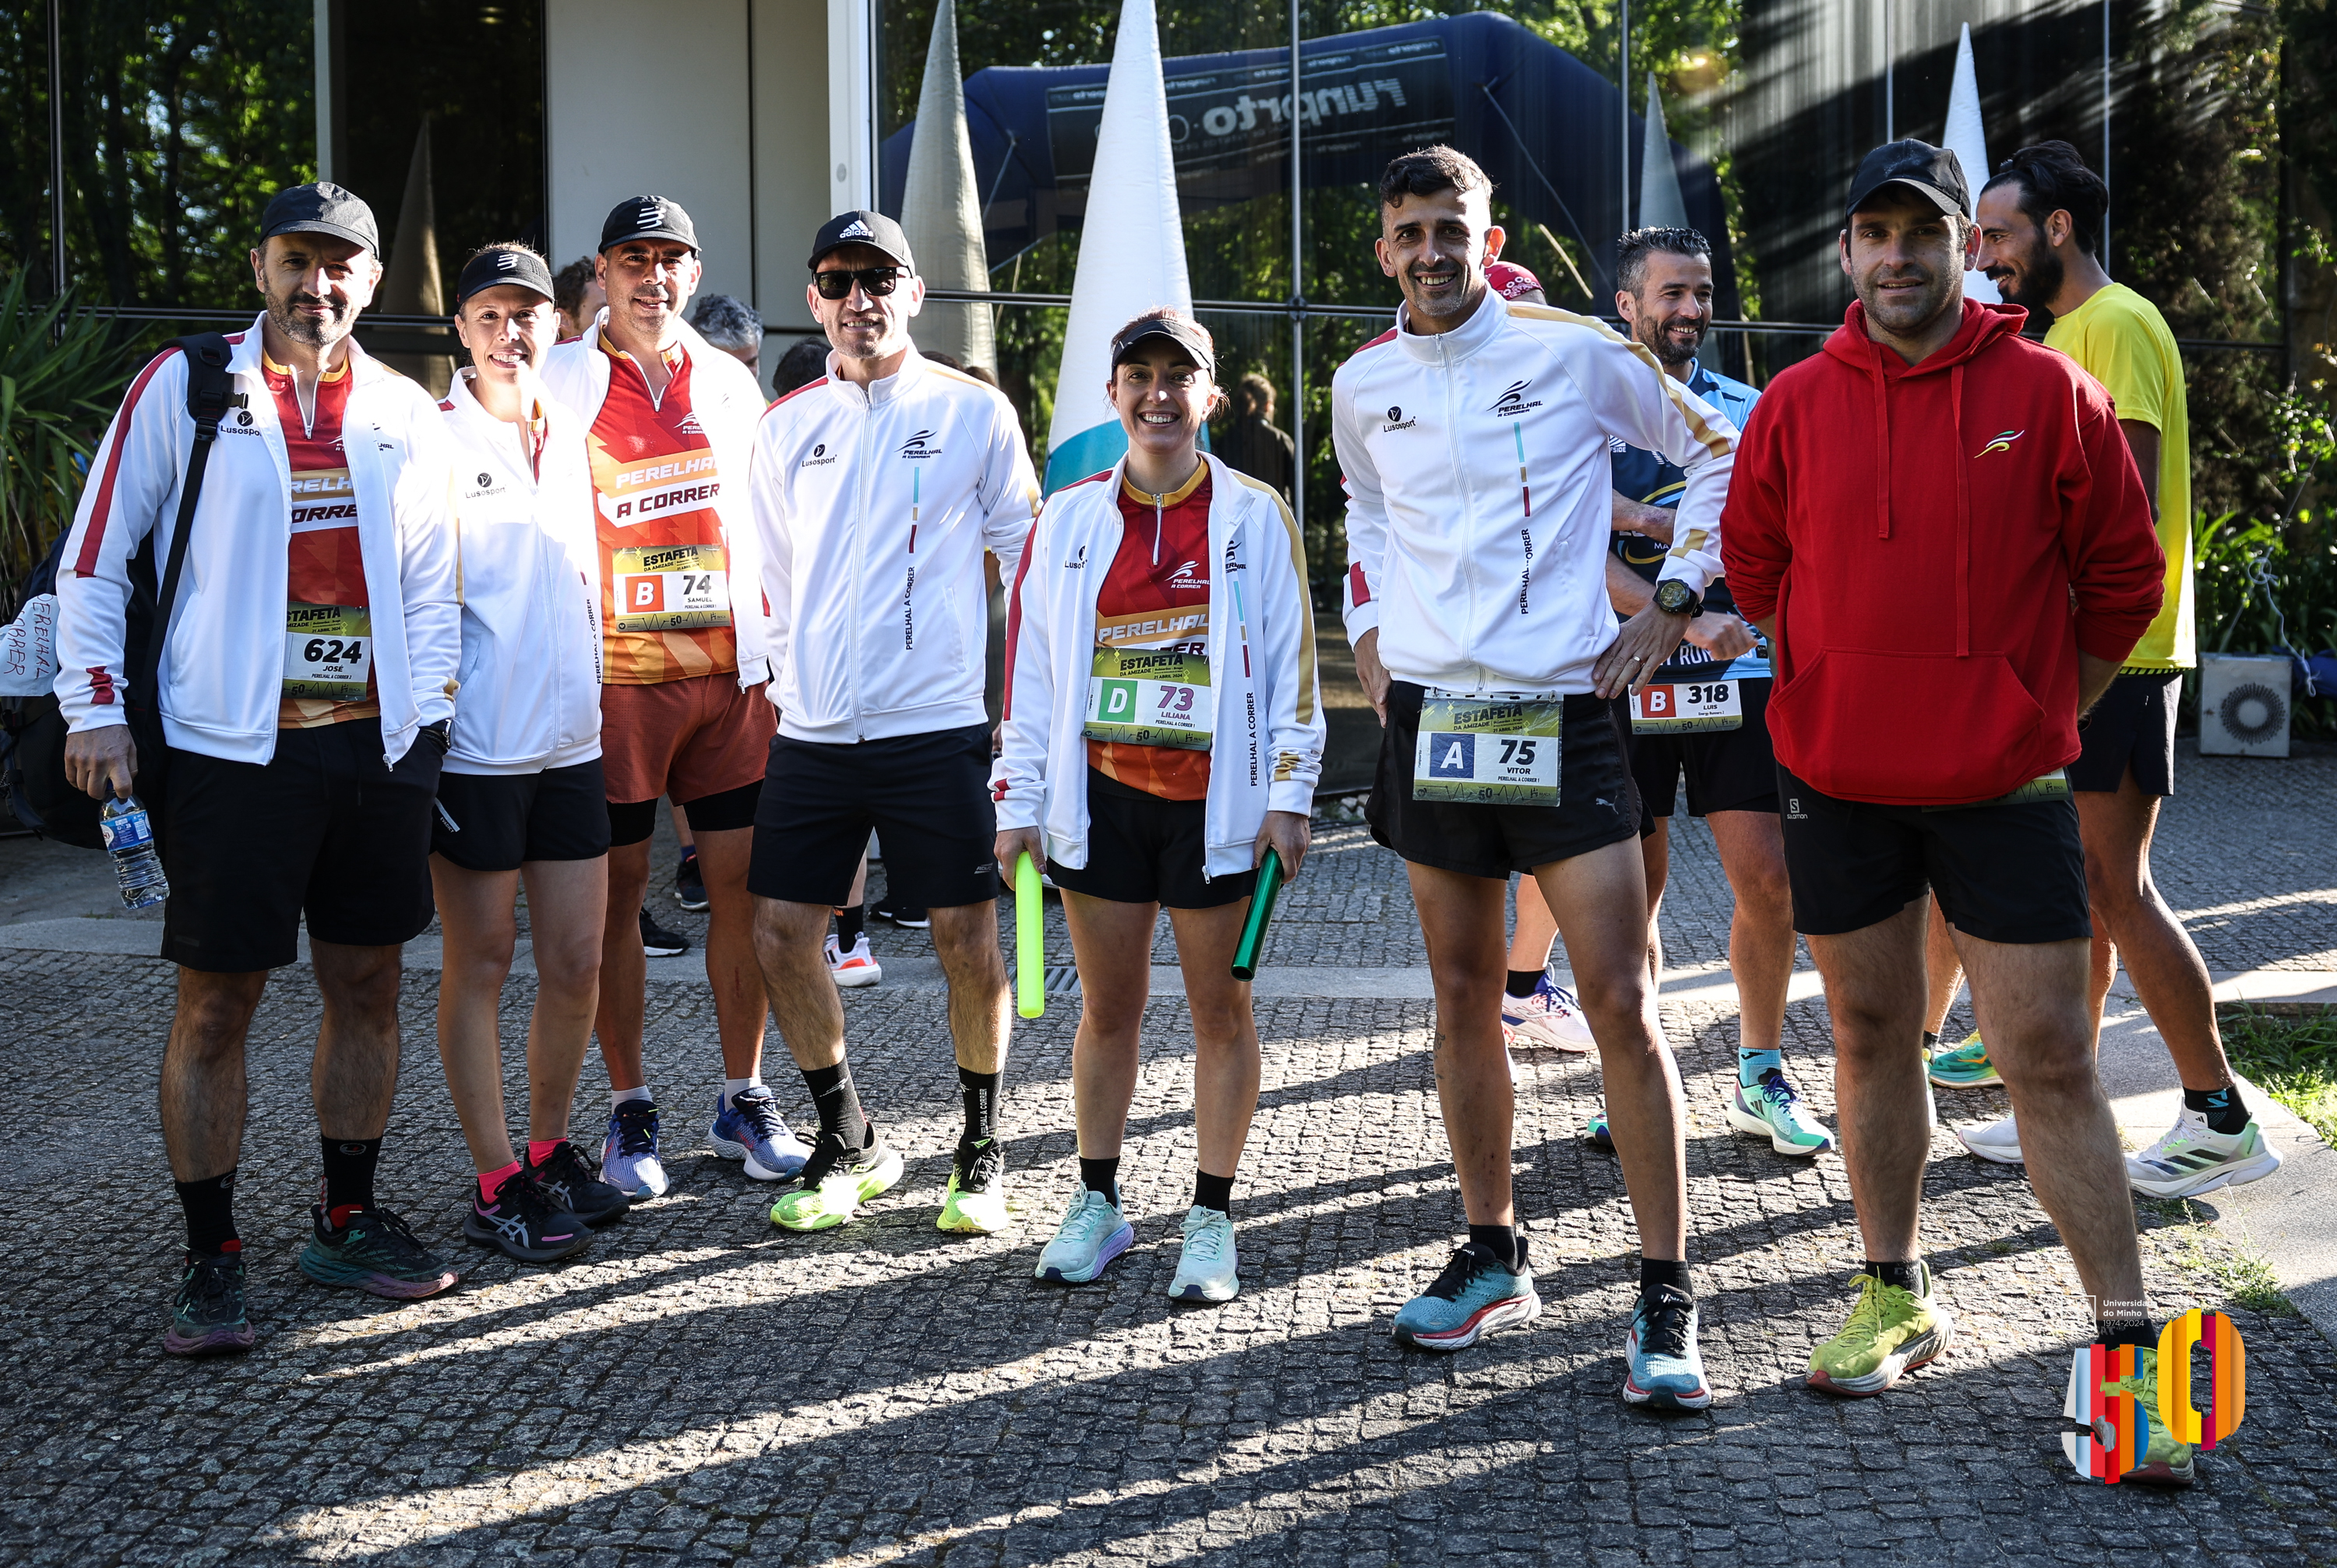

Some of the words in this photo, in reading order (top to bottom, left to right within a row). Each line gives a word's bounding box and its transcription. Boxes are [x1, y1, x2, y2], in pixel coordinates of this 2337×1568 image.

[839, 229, 874, 238] adidas
[1498, 400, 1542, 413] PERELHAL
[220, 425, 262, 437] Lusospo
[802, 456, 835, 467] Lusosport
[615, 456, 715, 489] PERELHA
[291, 476, 354, 494] RELH
[465, 487, 506, 499] Lusosport
[617, 502, 632, 519] A
[639, 483, 720, 513] CORRER
[291, 504, 358, 523] ORRE
[1521, 528, 1534, 562] ORRER
[643, 546, 699, 567] ESTAFETA
[683, 575, 712, 595] 74
[904, 566, 915, 598] CORRER
[635, 582, 654, 606] B
[287, 607, 341, 622] STAFETA
[670, 615, 682, 626] 50
[904, 608, 913, 650] PERELHAL
[1098, 614, 1208, 642] PERELHAL
[304, 638, 362, 664] 624
[1120, 654, 1183, 671] ESTAFETA
[291, 684, 305, 696] 50
[1157, 685, 1194, 711] 73
[1687, 684, 1729, 704] 318
[1107, 688, 1129, 714] D
[1246, 692, 1256, 730] CORRER
[1650, 691, 1666, 712] B
[1161, 711, 1191, 721] LILIANA
[1454, 704, 1523, 724] ESTAFETA
[1136, 729, 1150, 742] 50
[1463, 721, 1490, 730] AMIZADE
[1682, 721, 1693, 731] 50
[1440, 742, 1464, 769] A
[1498, 739, 1537, 765] 75
[1507, 766, 1531, 775] VITOR
[439, 816, 454, 833] EVADICT
[979, 1088, 988, 1110] CORRER
